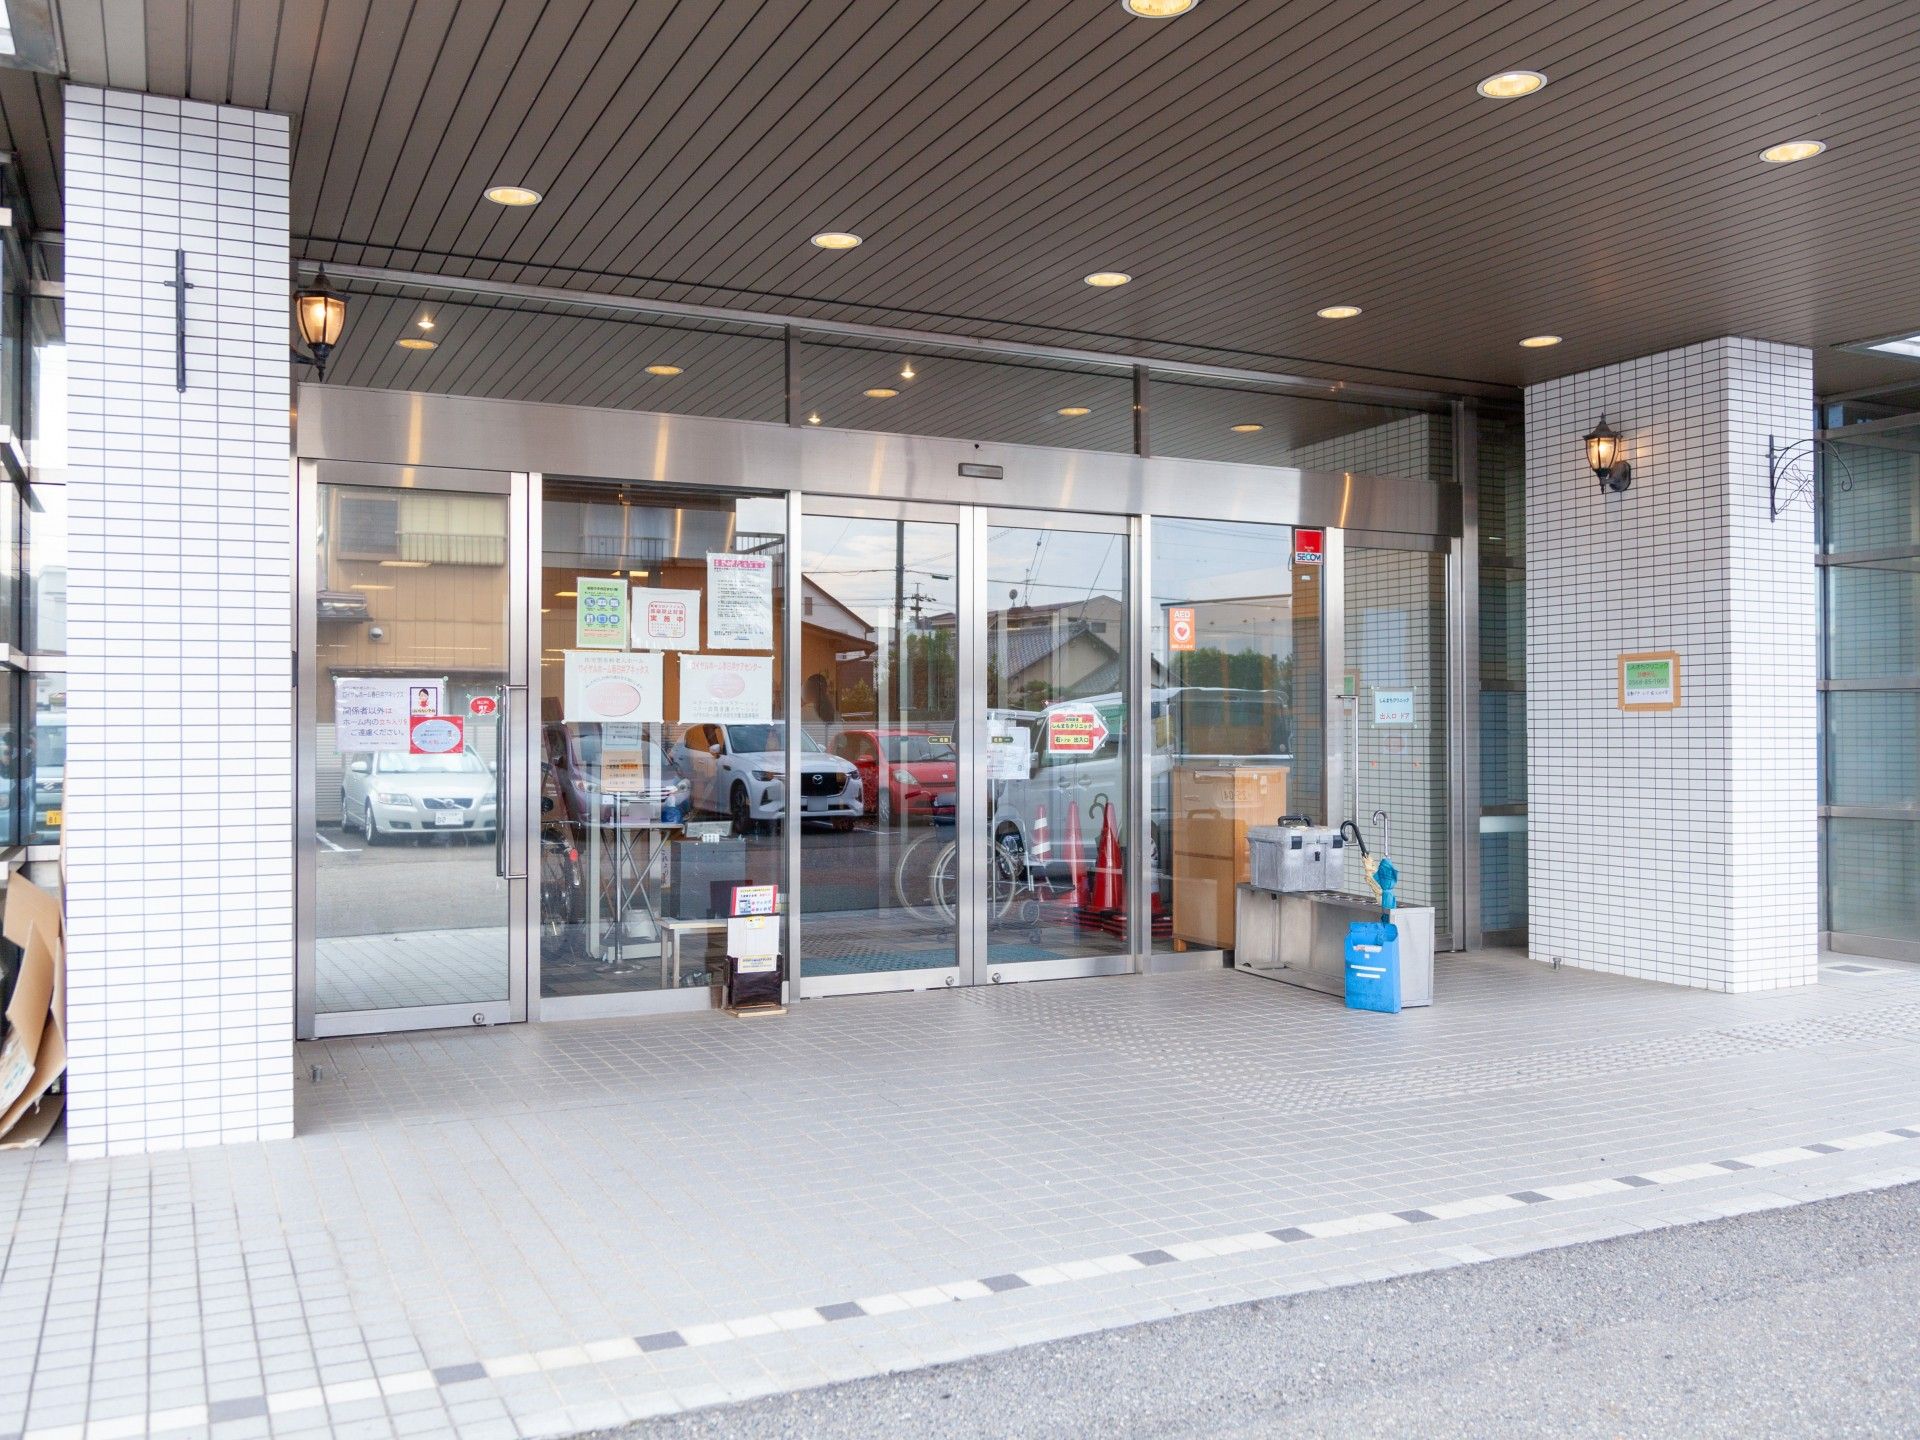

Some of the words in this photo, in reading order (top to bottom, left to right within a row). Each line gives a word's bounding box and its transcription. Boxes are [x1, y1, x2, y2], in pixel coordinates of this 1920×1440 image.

[1297, 553, 1321, 561] SECOM
[342, 706, 392, 715] 関係者以外は
